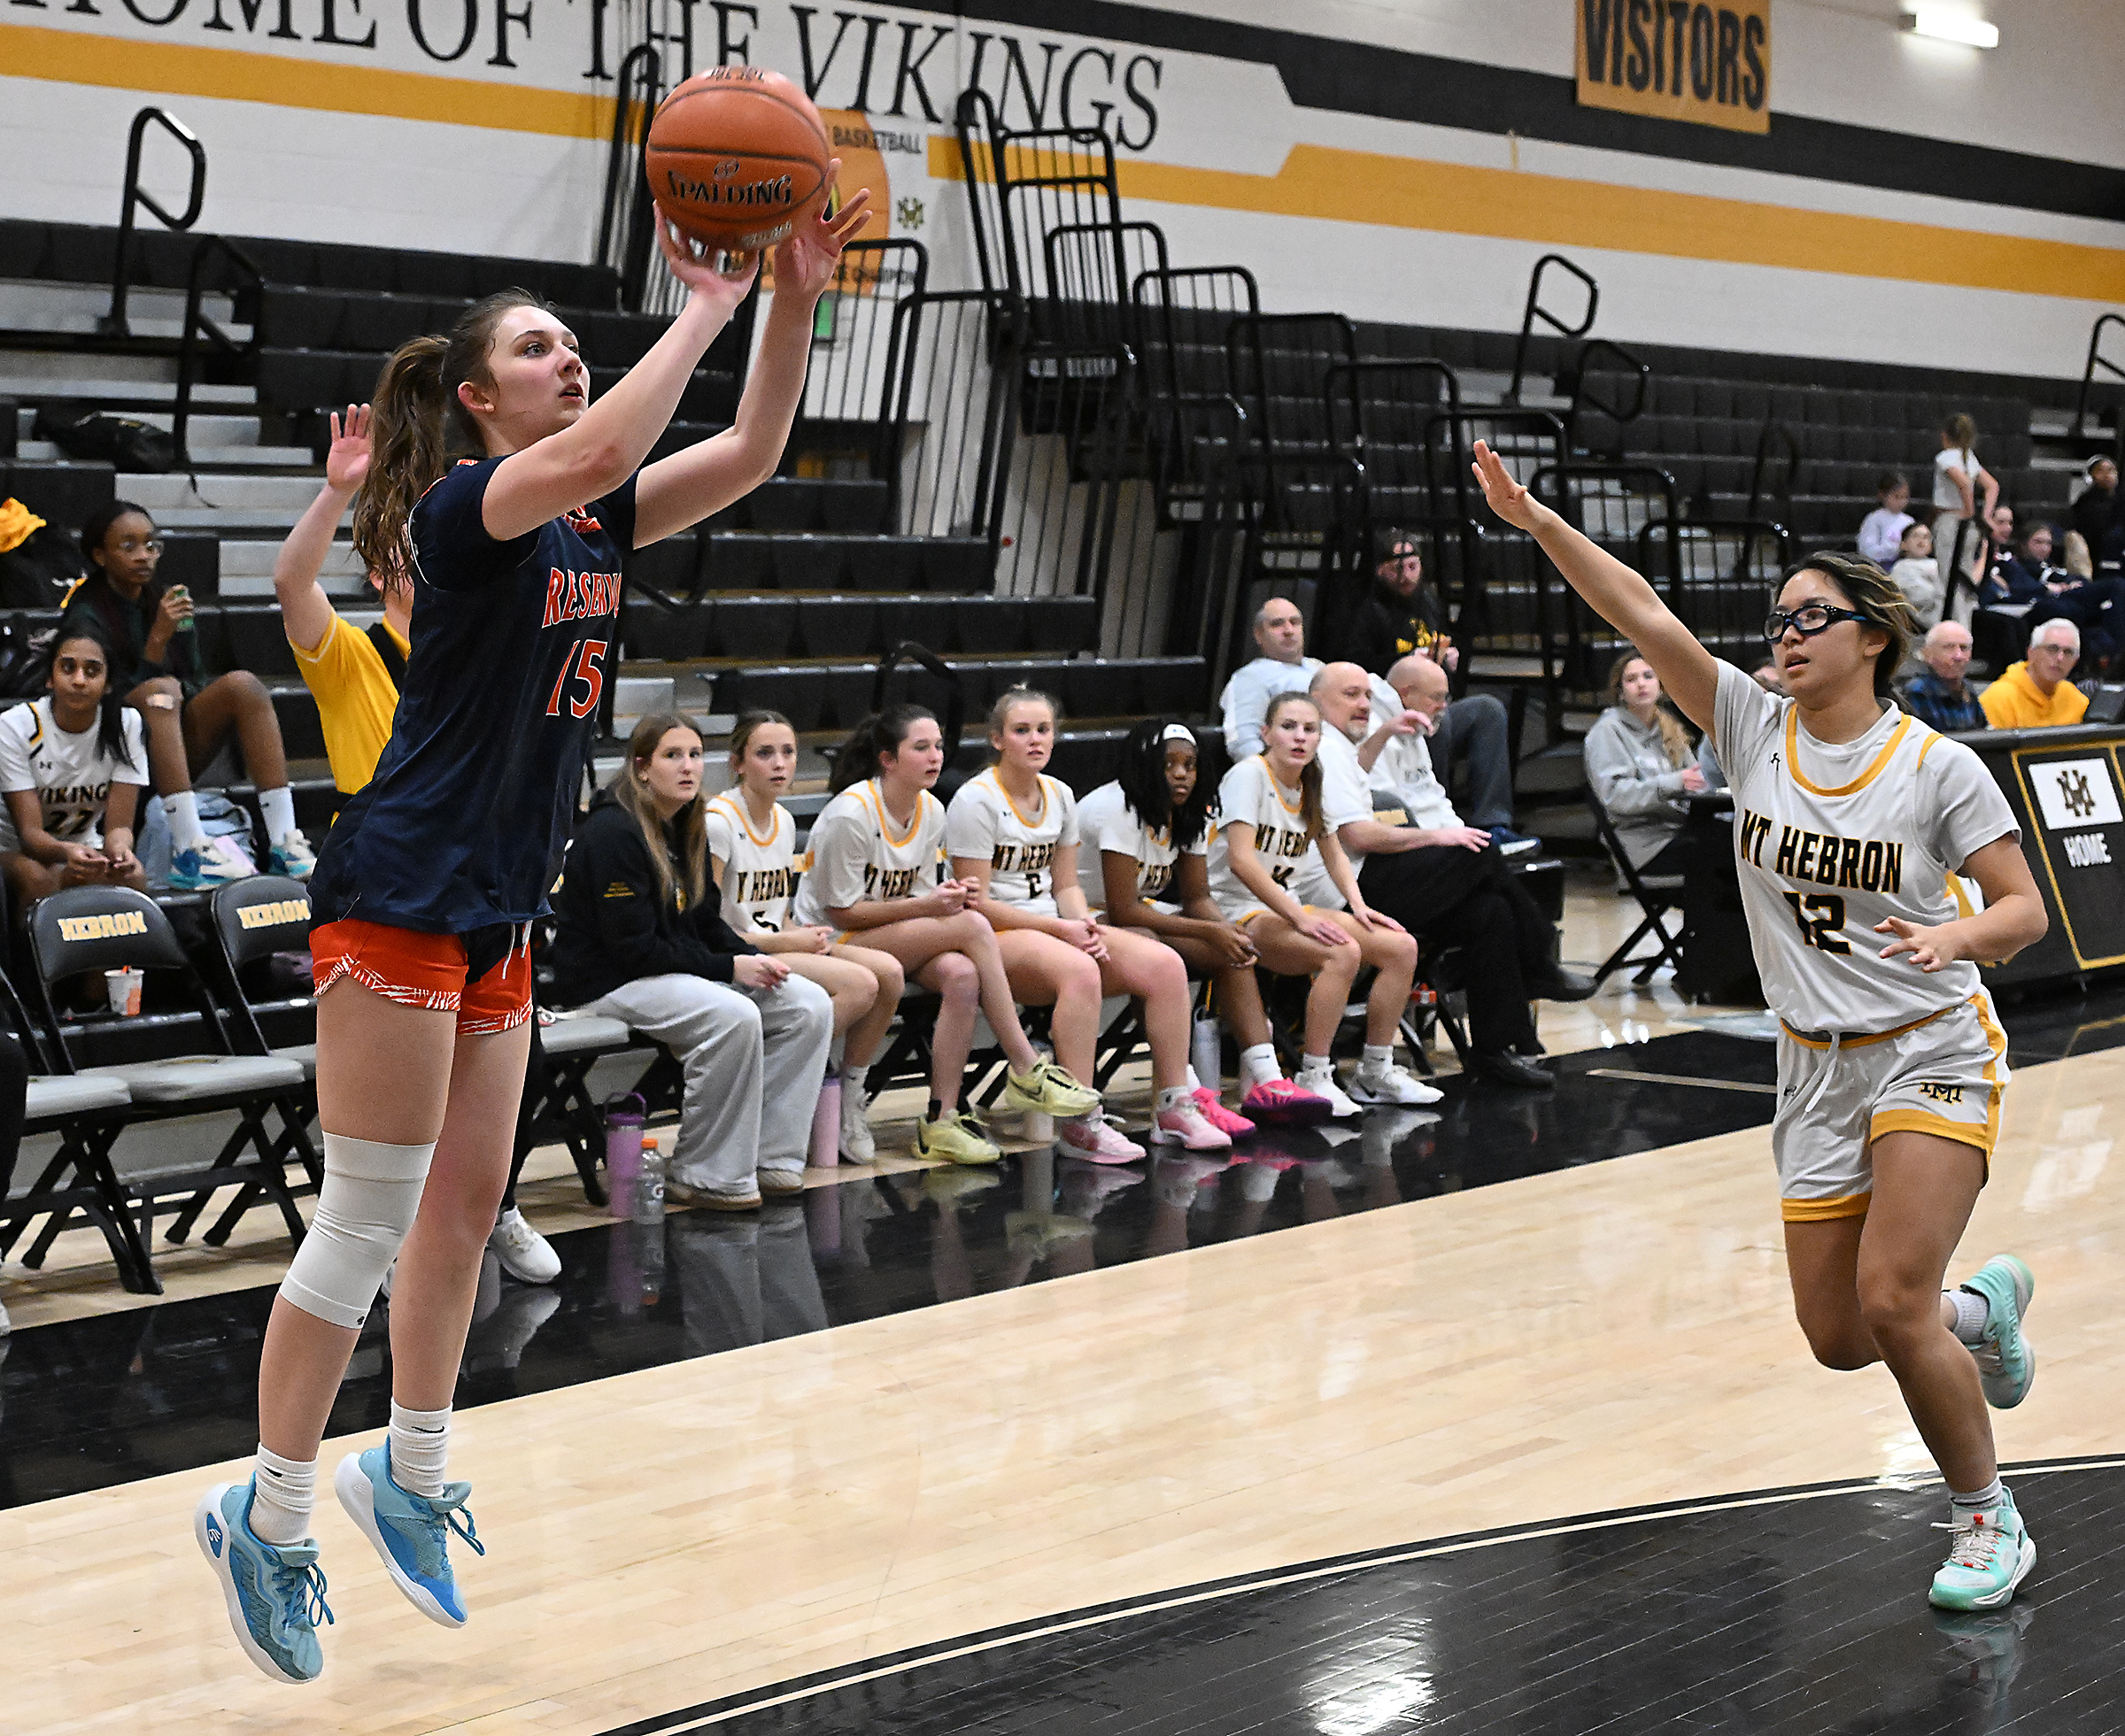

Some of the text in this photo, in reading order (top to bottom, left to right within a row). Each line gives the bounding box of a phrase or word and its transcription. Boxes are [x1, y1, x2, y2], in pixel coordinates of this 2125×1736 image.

[790, 5, 1163, 151] VIKINGS
[1584, 0, 1765, 111] VISITORS
[545, 639, 608, 719] 15
[1775, 824, 1903, 894] HEBRON
[2062, 832, 2112, 868] HOME
[58, 911, 148, 941] HEBRON
[1782, 891, 1852, 956] 12
